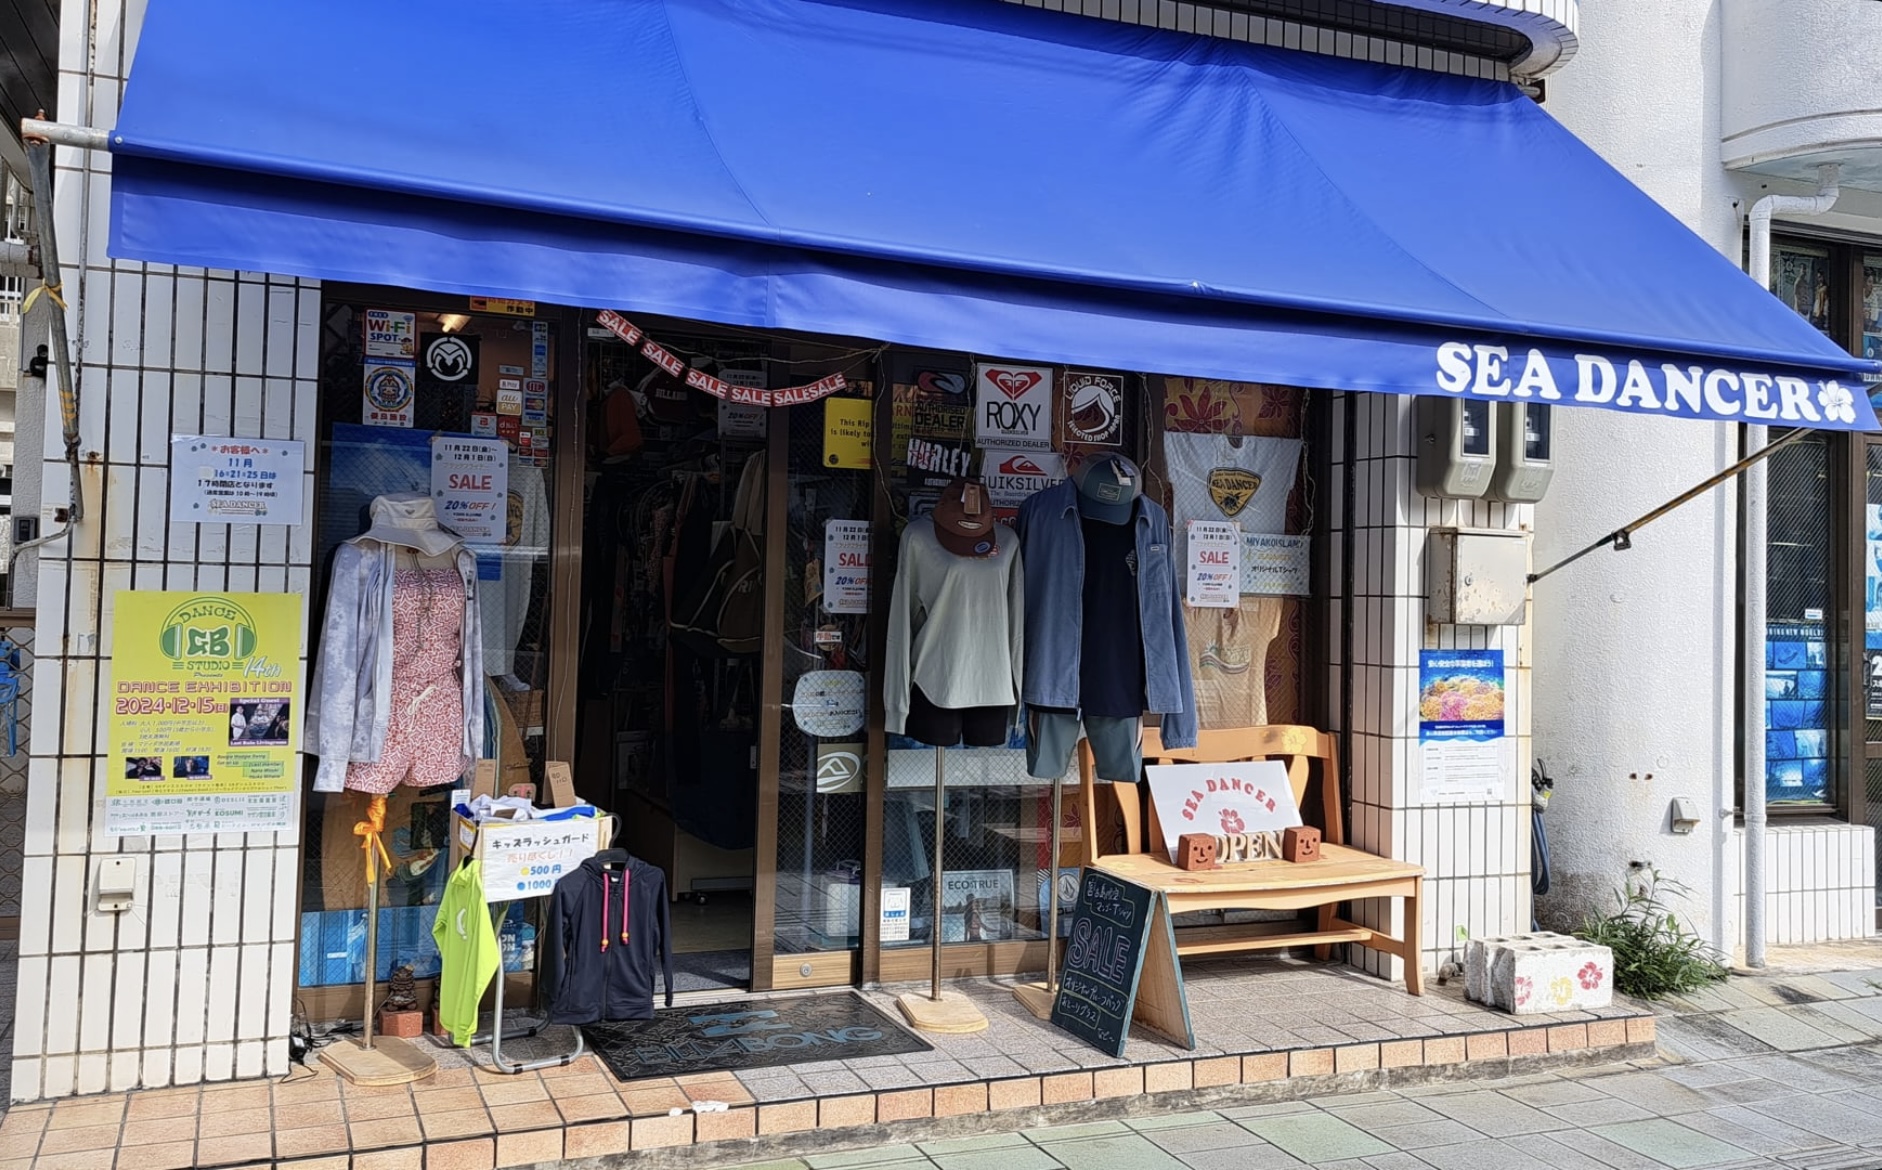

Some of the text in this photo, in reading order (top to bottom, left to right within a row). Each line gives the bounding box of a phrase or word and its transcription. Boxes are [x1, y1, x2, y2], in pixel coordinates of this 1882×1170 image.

[368, 319, 411, 334] Wi-Fi
[598, 309, 640, 345] SALE
[370, 332, 399, 341] SPOT
[642, 341, 683, 376] SALE
[687, 370, 728, 398] SALE
[808, 374, 846, 398] SALE
[1065, 376, 1121, 402] LIQUID FORCE
[1437, 341, 1821, 423] SEA DANCER
[731, 388, 771, 405] SALE
[773, 389, 810, 406] SALE
[502, 402, 517, 410] PAY
[840, 419, 870, 428] This Rip
[915, 413, 965, 427] DEALER
[986, 401, 1041, 431] ROXY
[840, 428, 860, 438] likely
[977, 440, 1020, 448] AUTHORIZED
[228, 458, 253, 468] 11月
[907, 438, 971, 477] HURLEY
[449, 473, 492, 490] SALE
[1199, 551, 1229, 564] SALE
[179, 605, 236, 623] DANCE
[187, 626, 231, 656] GB
[186, 660, 231, 671] STUDIO
[243, 656, 282, 678] 14th
[117, 680, 292, 693] DANCE EXHIBITION
[1182, 778, 1277, 821] SEA DANCER
[528, 879, 557, 890] 1000
[1067, 917, 1132, 985] SALE
[633, 1025, 883, 1065] BILLABONG
